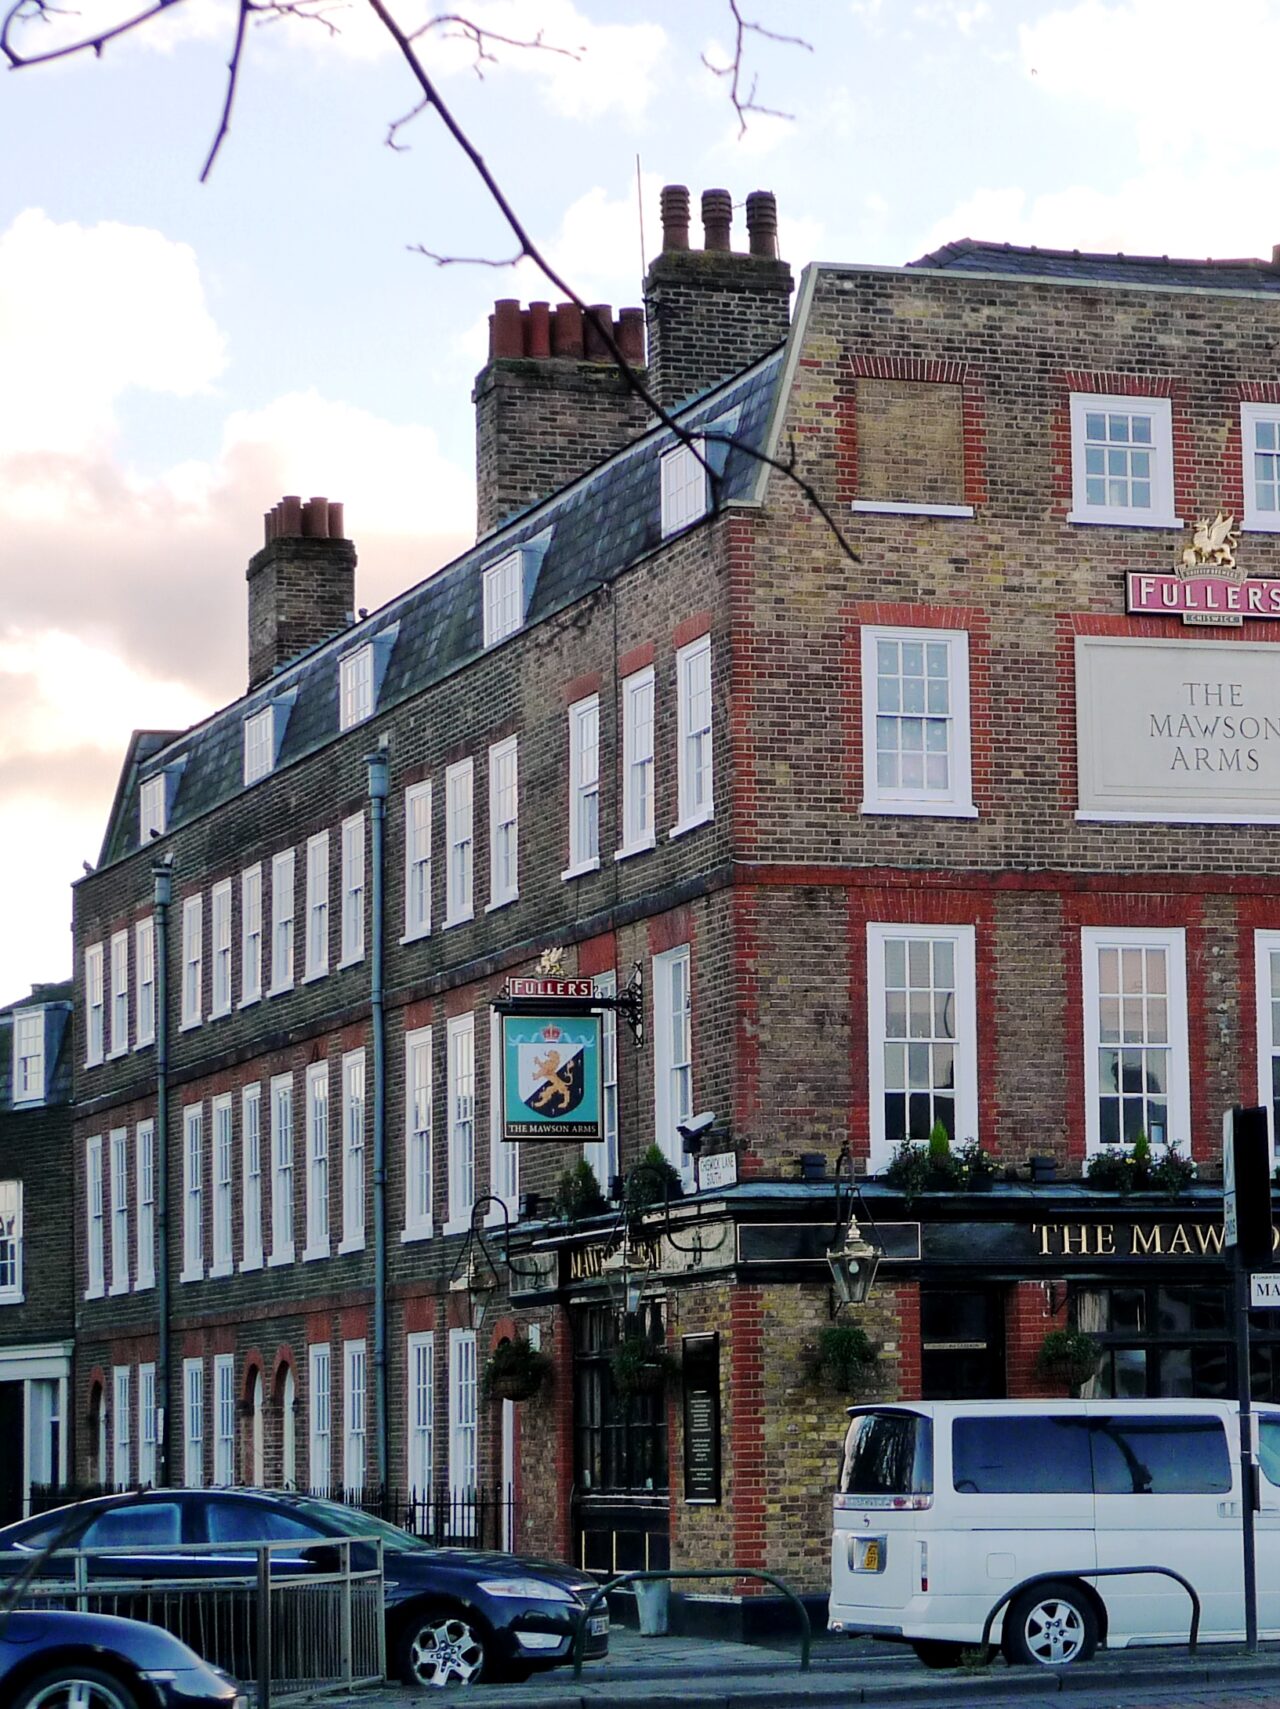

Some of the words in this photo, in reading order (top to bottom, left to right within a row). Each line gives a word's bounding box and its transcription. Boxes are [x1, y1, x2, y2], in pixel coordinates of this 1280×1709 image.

[1183, 682, 1244, 707] THE
[1170, 746, 1260, 772] ARMS
[514, 980, 589, 997] FULLER'S
[508, 1123, 528, 1134] THE
[529, 1123, 570, 1134] MAWSON
[572, 1123, 596, 1134] ARMS
[1032, 1223, 1116, 1255] THE
